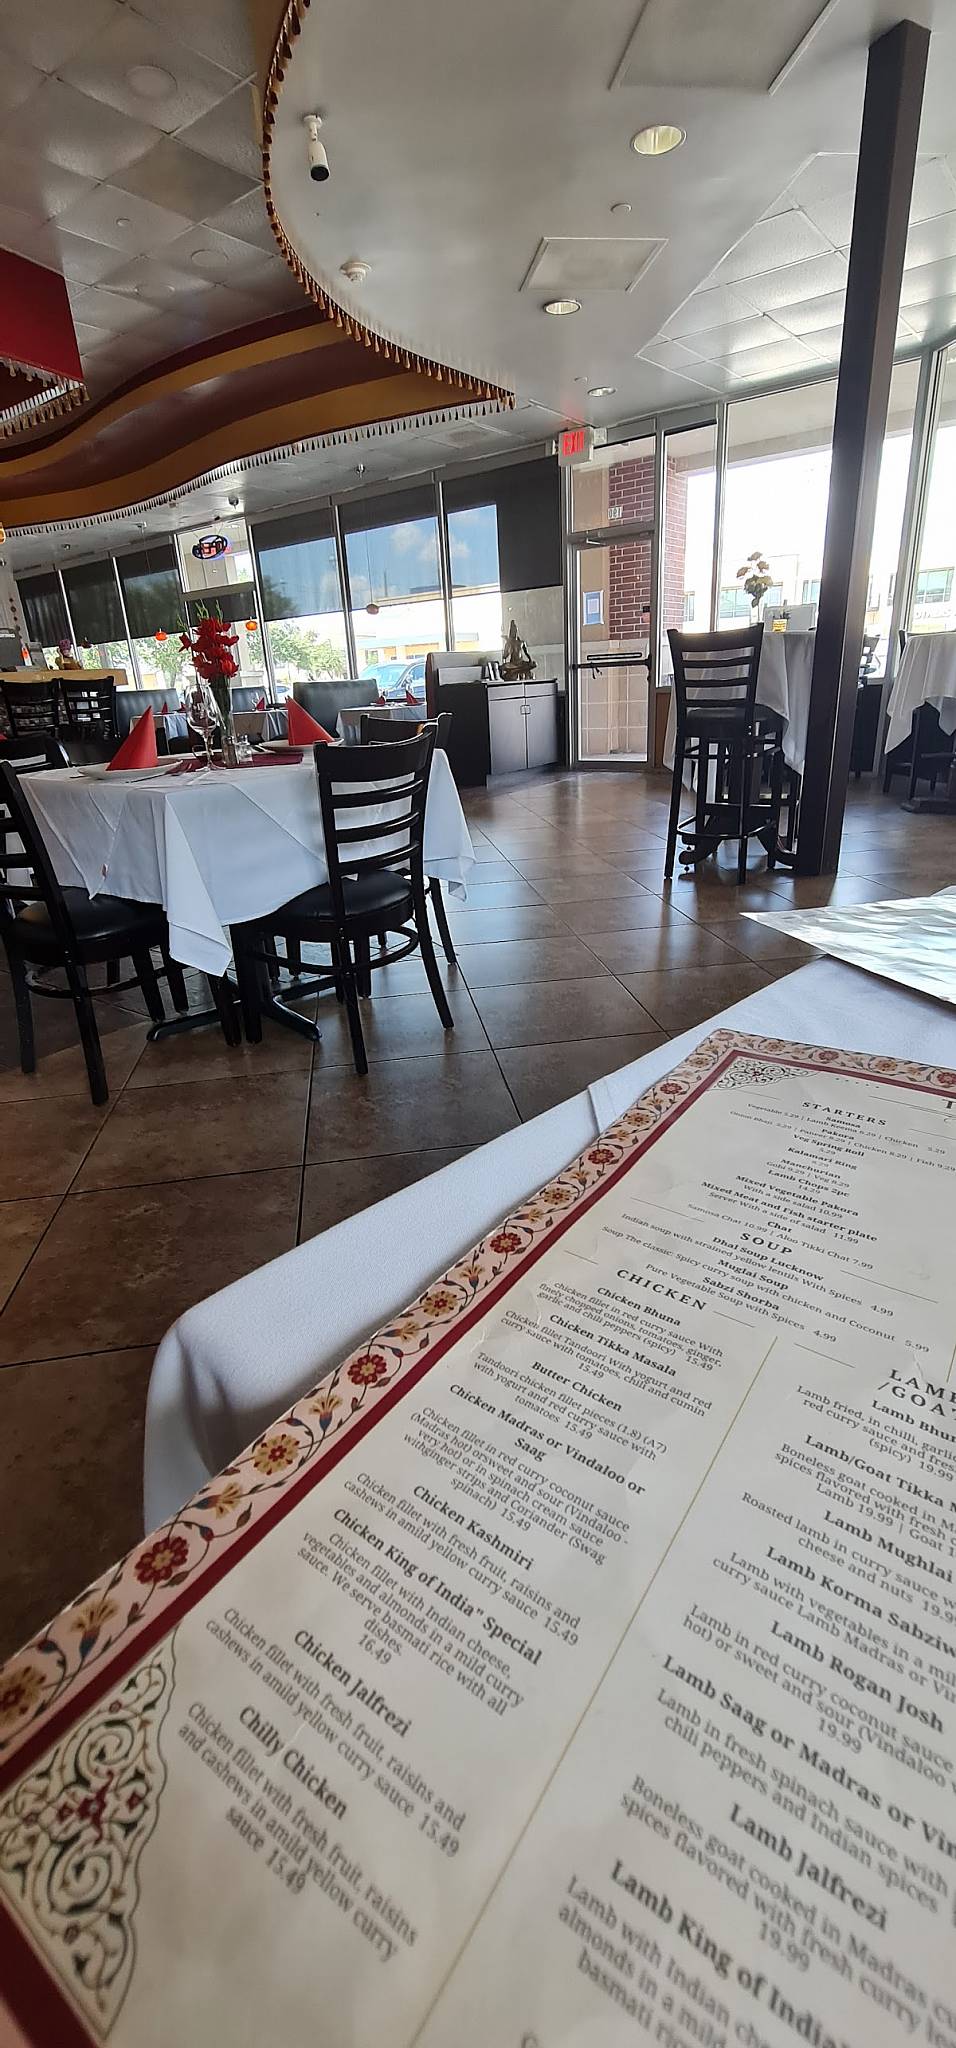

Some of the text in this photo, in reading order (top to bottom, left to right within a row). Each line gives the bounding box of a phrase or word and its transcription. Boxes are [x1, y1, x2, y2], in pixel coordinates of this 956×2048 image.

[802, 1102, 886, 1126] STARTERS
[781, 1159, 841, 1179] Manchurian
[794, 1134, 865, 1157] Veg Spring Roll
[835, 1160, 857, 1170] Ring
[736, 1175, 767, 1188] Mixed
[769, 1185, 818, 1203] Vegetable
[744, 1184, 764, 1195] With
[773, 1194, 791, 1203] side
[792, 1201, 817, 1211] salad
[768, 1169, 796, 1181] Lamb
[798, 1178, 829, 1191] Chops
[701, 1182, 877, 1241] Mixed Meat and Fish starter plate
[740, 1201, 760, 1212] With
[769, 1212, 788, 1220] side
[801, 1223, 827, 1234] salad
[767, 1221, 792, 1233] Chat
[621, 1213, 649, 1227] Indian
[650, 1225, 672, 1235] soup
[673, 1233, 693, 1243] with
[694, 1240, 733, 1257] strained
[733, 1255, 767, 1269] yellow
[768, 1266, 799, 1282] lentils
[802, 1278, 826, 1293] With
[828, 1289, 862, 1305] Spices
[712, 1237, 824, 1281] Dhal Soup Lucknow
[740, 1233, 792, 1254] SOUP
[564, 1296, 603, 1315] chopped
[597, 1287, 681, 1326] Chicken Bhuna
[602, 1226, 624, 1237] Soup
[625, 1234, 642, 1244] The
[675, 1253, 701, 1267] Spicy
[702, 1264, 730, 1278] curry
[729, 1275, 754, 1287] soup
[757, 1284, 780, 1297] with
[782, 1294, 822, 1314] chicken
[824, 1311, 847, 1323] and
[849, 1320, 895, 1341] Coconut
[617, 1269, 707, 1310] CHICKEN
[646, 1263, 668, 1276] Pure
[671, 1273, 716, 1295] Vegetable
[717, 1292, 743, 1306] Soup
[746, 1303, 769, 1316] with
[771, 1312, 805, 1330] Spices
[702, 1277, 779, 1311] Sabzi Shorba
[759, 1275, 789, 1290] Soup
[550, 1314, 676, 1377] Chicken Tikka Masala
[554, 1282, 723, 1357] chicken fillet in red curry sauce With
[477, 1352, 520, 1378] Tandoori
[519, 1375, 557, 1398] chicken
[557, 1393, 582, 1410] fillet
[581, 1407, 616, 1427] pieces
[531, 1361, 622, 1412] Butter Chicken
[872, 1400, 915, 1425] Lamb
[878, 1382, 956, 1420] /GOA
[450, 1384, 646, 1494] Chicken Madras or Vindaloo or
[514, 1438, 547, 1462] Saag
[805, 1434, 943, 1507] Lamb/Goat Tikka
[413, 1486, 534, 1571] Chicken Kashmiri
[816, 1483, 894, 1526] Lamb 19.99
[344, 1481, 578, 1646] cashews in amild yellow curry sauce 15.49
[742, 1492, 938, 1601] Roasted lamb in curry sauce
[824, 1510, 952, 1583] Lamb Mughlai
[334, 1509, 384, 1551] Chicken
[384, 1545, 419, 1578] King
[418, 1572, 439, 1588] of
[483, 1617, 542, 1665] Special
[766, 1546, 815, 1581] Lamb
[820, 1575, 882, 1619] Korma
[294, 1630, 412, 1738] Chicken Jalfrezi
[770, 1620, 943, 1733] Lamb Rogan Josh
[239, 1706, 347, 1820] Chilly Chicken
[663, 1655, 716, 1699] Lamb
[720, 1693, 767, 1737] Saag
[770, 1728, 795, 1749] or
[799, 1743, 881, 1809] Madras
[887, 1805, 914, 1831] or
[730, 1803, 887, 1931] Lamb Jalfrezi
[611, 1859, 673, 1924] Lamb
[678, 1913, 733, 1980] King
[737, 1967, 767, 1999] of
